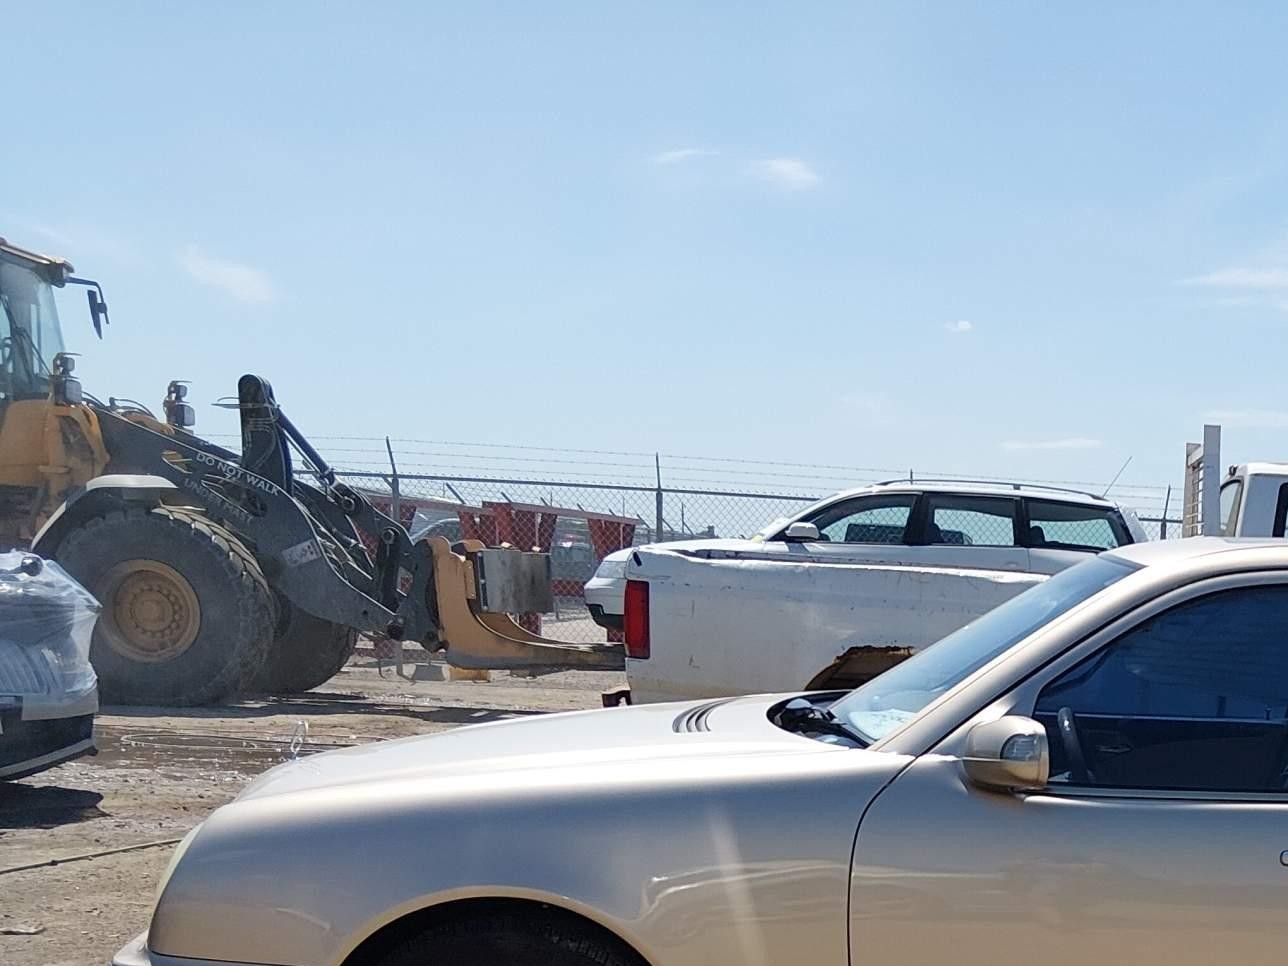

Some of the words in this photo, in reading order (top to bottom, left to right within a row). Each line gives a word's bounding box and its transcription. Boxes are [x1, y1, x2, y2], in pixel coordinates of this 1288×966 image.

[196, 453, 215, 466] DO
[217, 462, 243, 480] NOT
[246, 474, 279, 496] WALK
